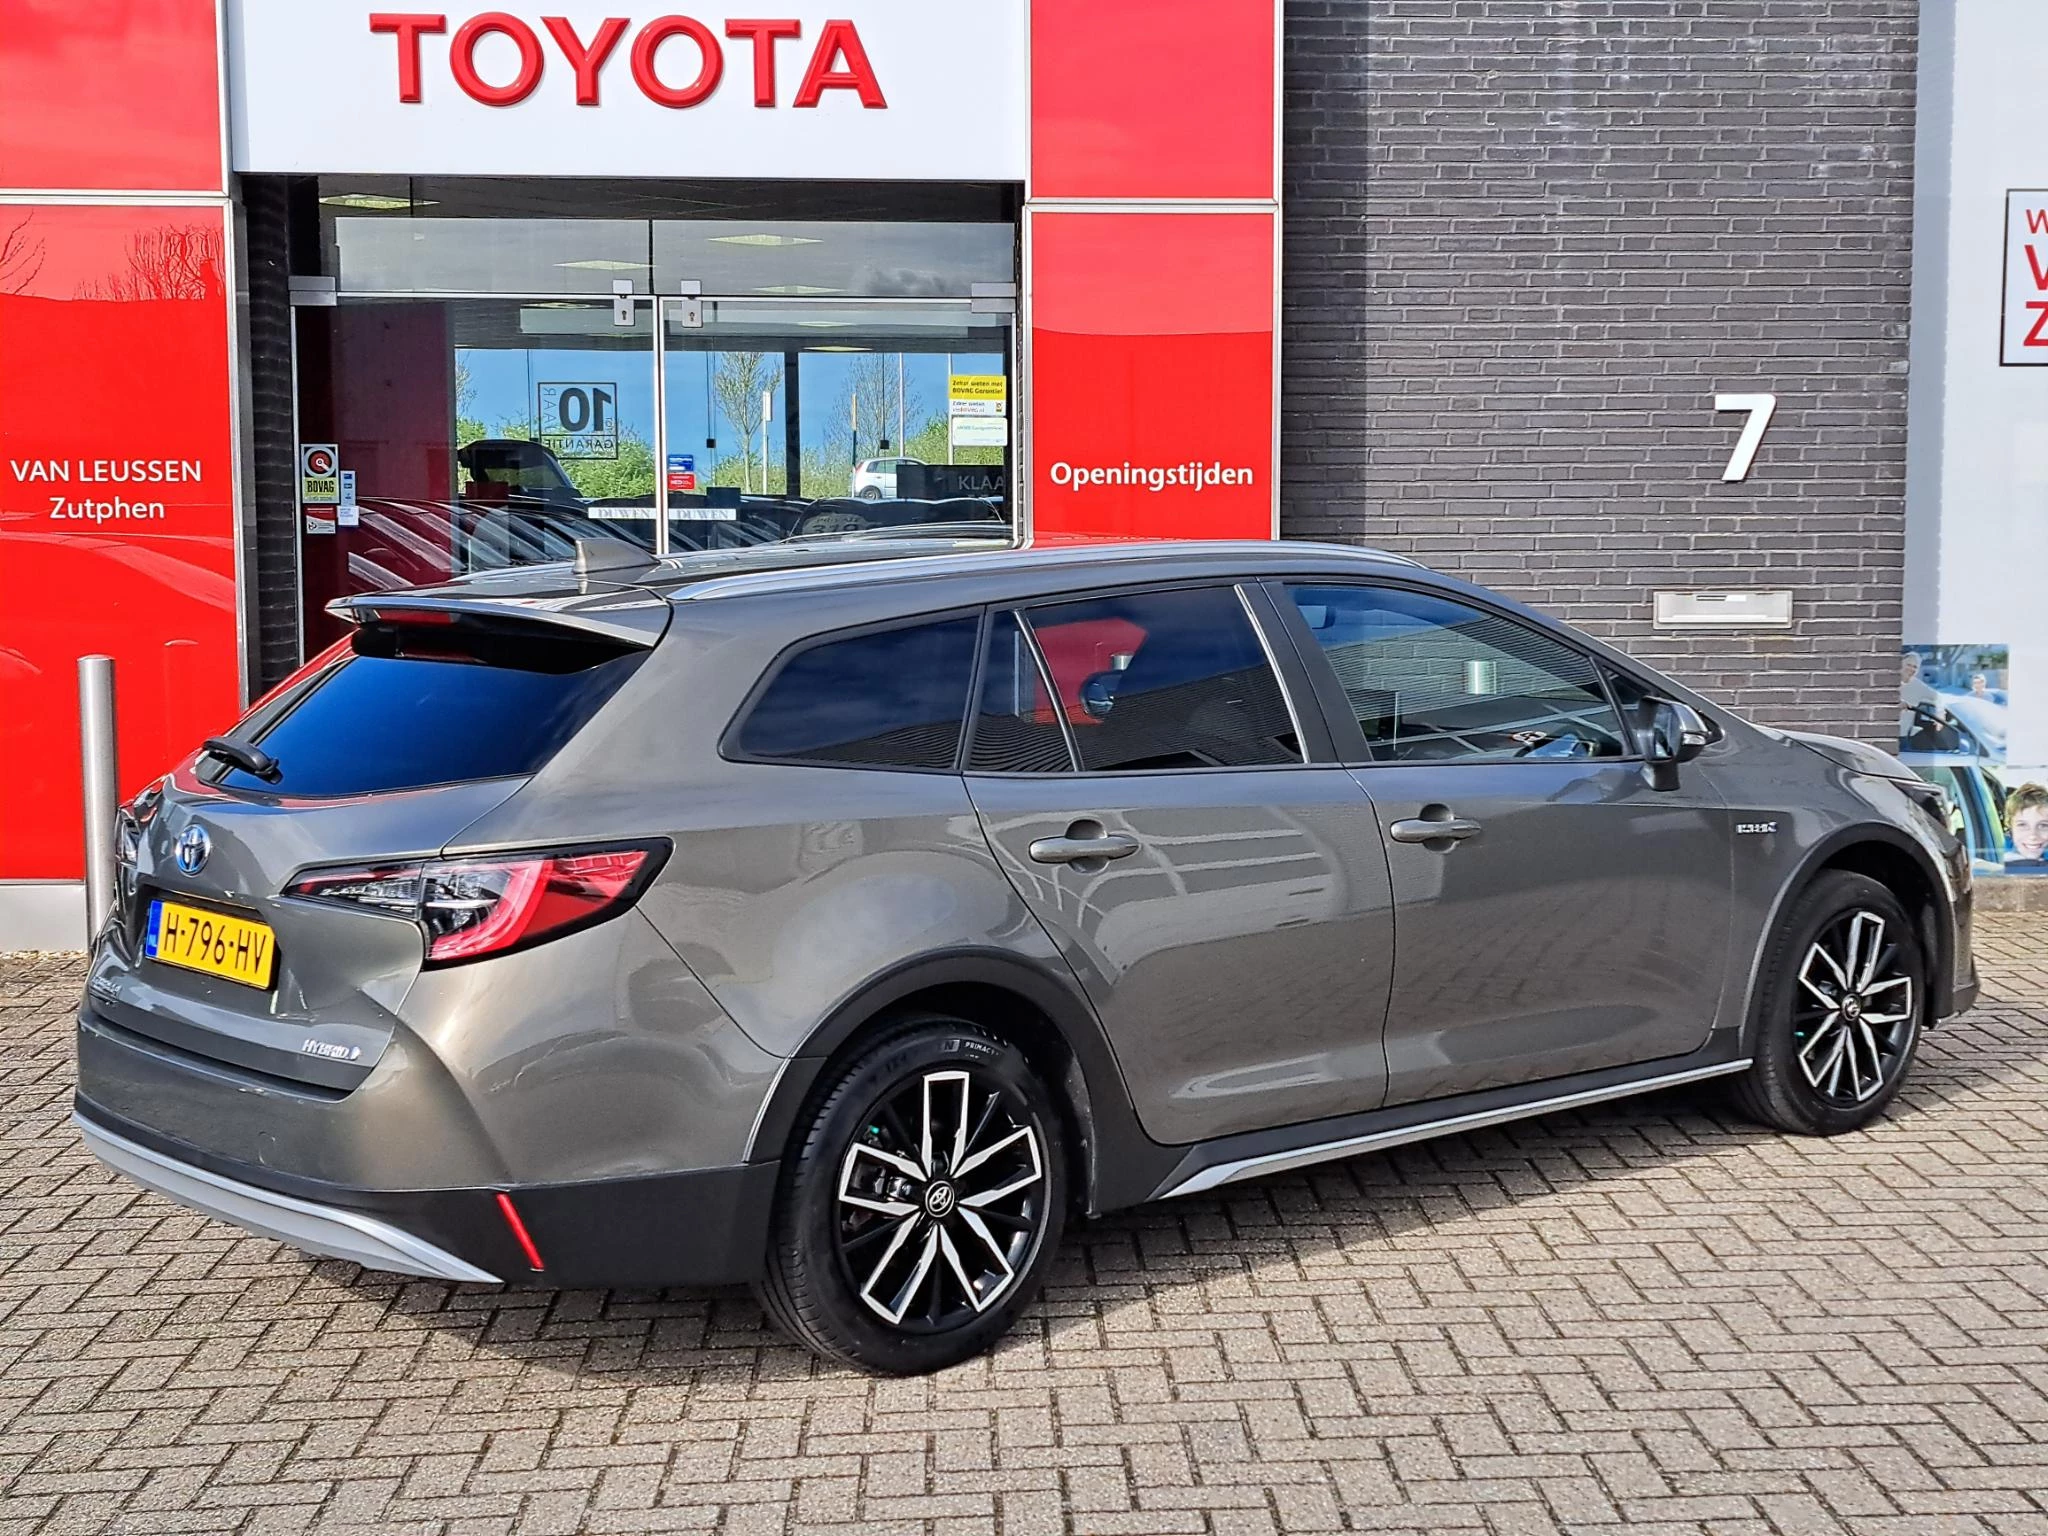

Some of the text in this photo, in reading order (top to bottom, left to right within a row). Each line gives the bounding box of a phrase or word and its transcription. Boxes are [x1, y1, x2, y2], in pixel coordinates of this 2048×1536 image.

[370, 12, 888, 109] TOYOTA
[1715, 394, 1776, 481] 7
[10, 460, 201, 482] VAN LEUSSEN
[1050, 462, 1253, 492] Openingstijden
[307, 480, 334, 493] BOVAG
[49, 496, 165, 524] Zutphen
[599, 509, 651, 519] DUWEN
[677, 510, 729, 520] DUWEN
[164, 912, 267, 975] H-796-HV
[302, 1039, 349, 1059] HYBRID
